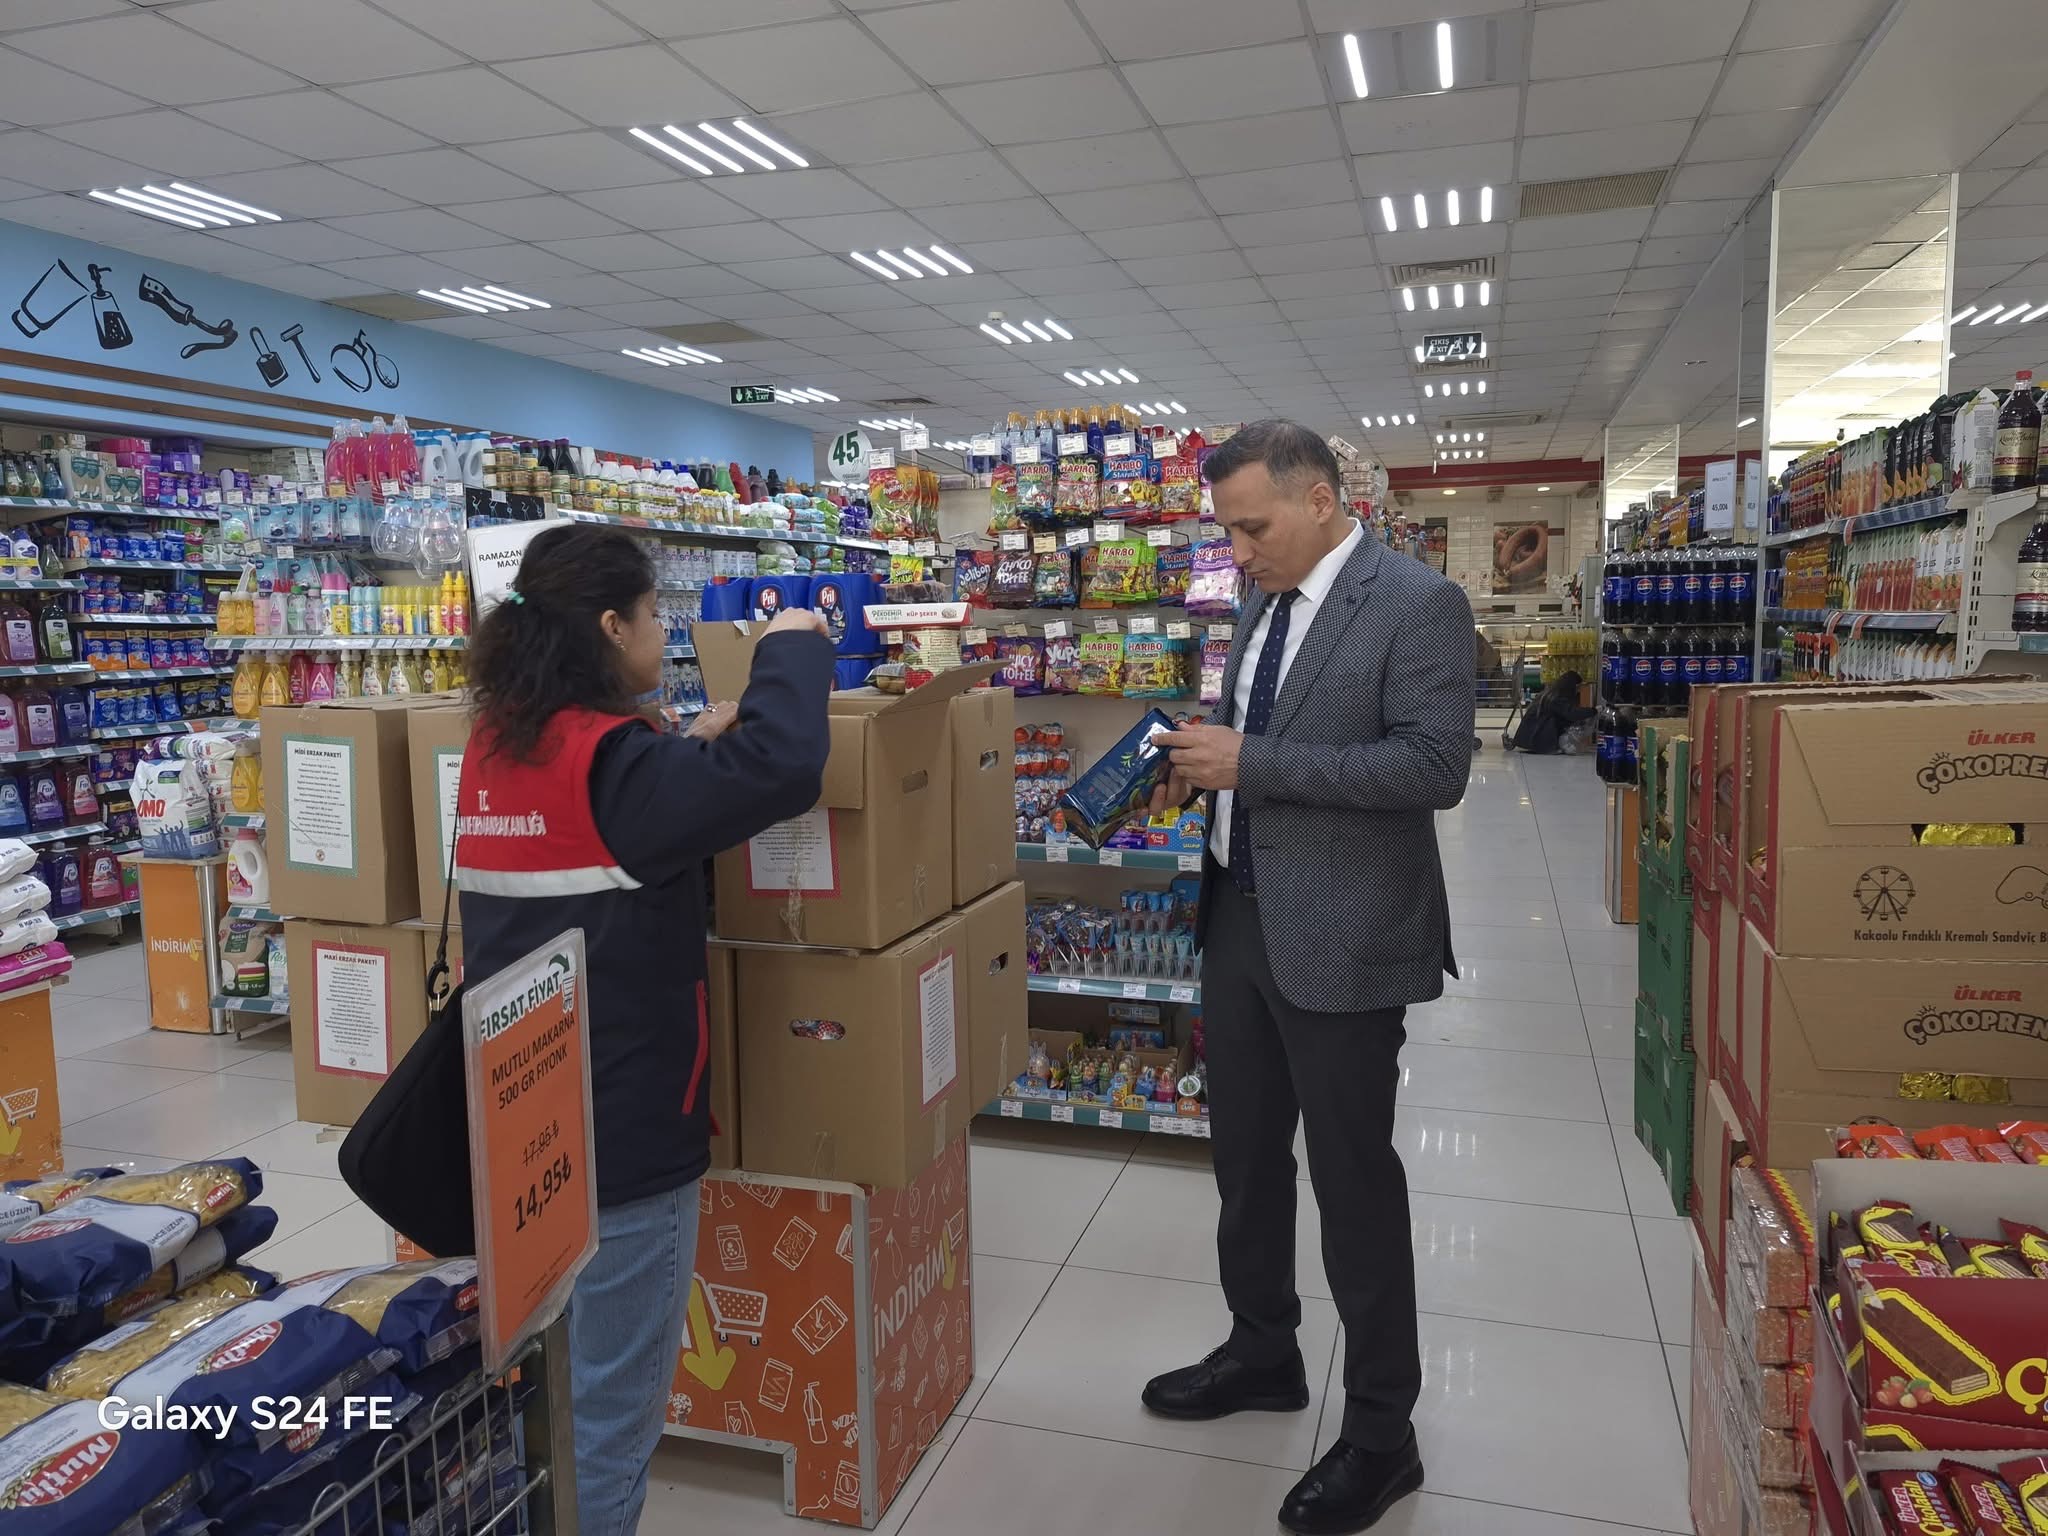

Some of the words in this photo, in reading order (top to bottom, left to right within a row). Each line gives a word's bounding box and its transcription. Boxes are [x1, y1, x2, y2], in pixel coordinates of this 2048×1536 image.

[833, 430, 860, 467] 45
[1061, 464, 1095, 474] HARIBO
[1109, 460, 1143, 470] HARIBO
[479, 550, 522, 562] RAMAZAN
[1103, 546, 1136, 557] HARIBO
[1000, 559, 1033, 572] CHOCO
[960, 564, 992, 586] Jelibon
[762, 592, 777, 604] Pril
[821, 590, 836, 603] Pril
[1084, 642, 1119, 651] HARIBO
[1128, 642, 1163, 651] HARIBO
[1002, 668, 1035, 681] TOFFEE
[1967, 729, 2036, 746] ÜLKER
[306, 749, 324, 757] ERZAK
[323, 750, 341, 759] PAKETİ
[1917, 754, 2048, 794] ÇOKOPRE
[151, 936, 193, 954] İNDİRİM
[1854, 929, 1898, 941] Kakaolu
[1902, 930, 1942, 942] Fındıklı
[1945, 931, 1989, 942] Kremalı
[1992, 931, 2036, 945] Sandviç
[1954, 985, 2022, 1002] ÜLKER
[480, 994, 525, 1039] FIRSAT
[527, 971, 561, 1009] FİYAT
[491, 1047, 530, 1086] MUTLU
[532, 1013, 575, 1056] MAKARNA
[498, 1081, 519, 1110] 500
[521, 1072, 536, 1092] GR
[207, 1184, 233, 1207] Mutlu
[873, 1244, 946, 1356] İNDİRİM
[20, 1435, 112, 1504] Mutlu
[1892, 1487, 1920, 1523] ÜLKER
[1971, 1484, 2002, 1523] ÜLKER
